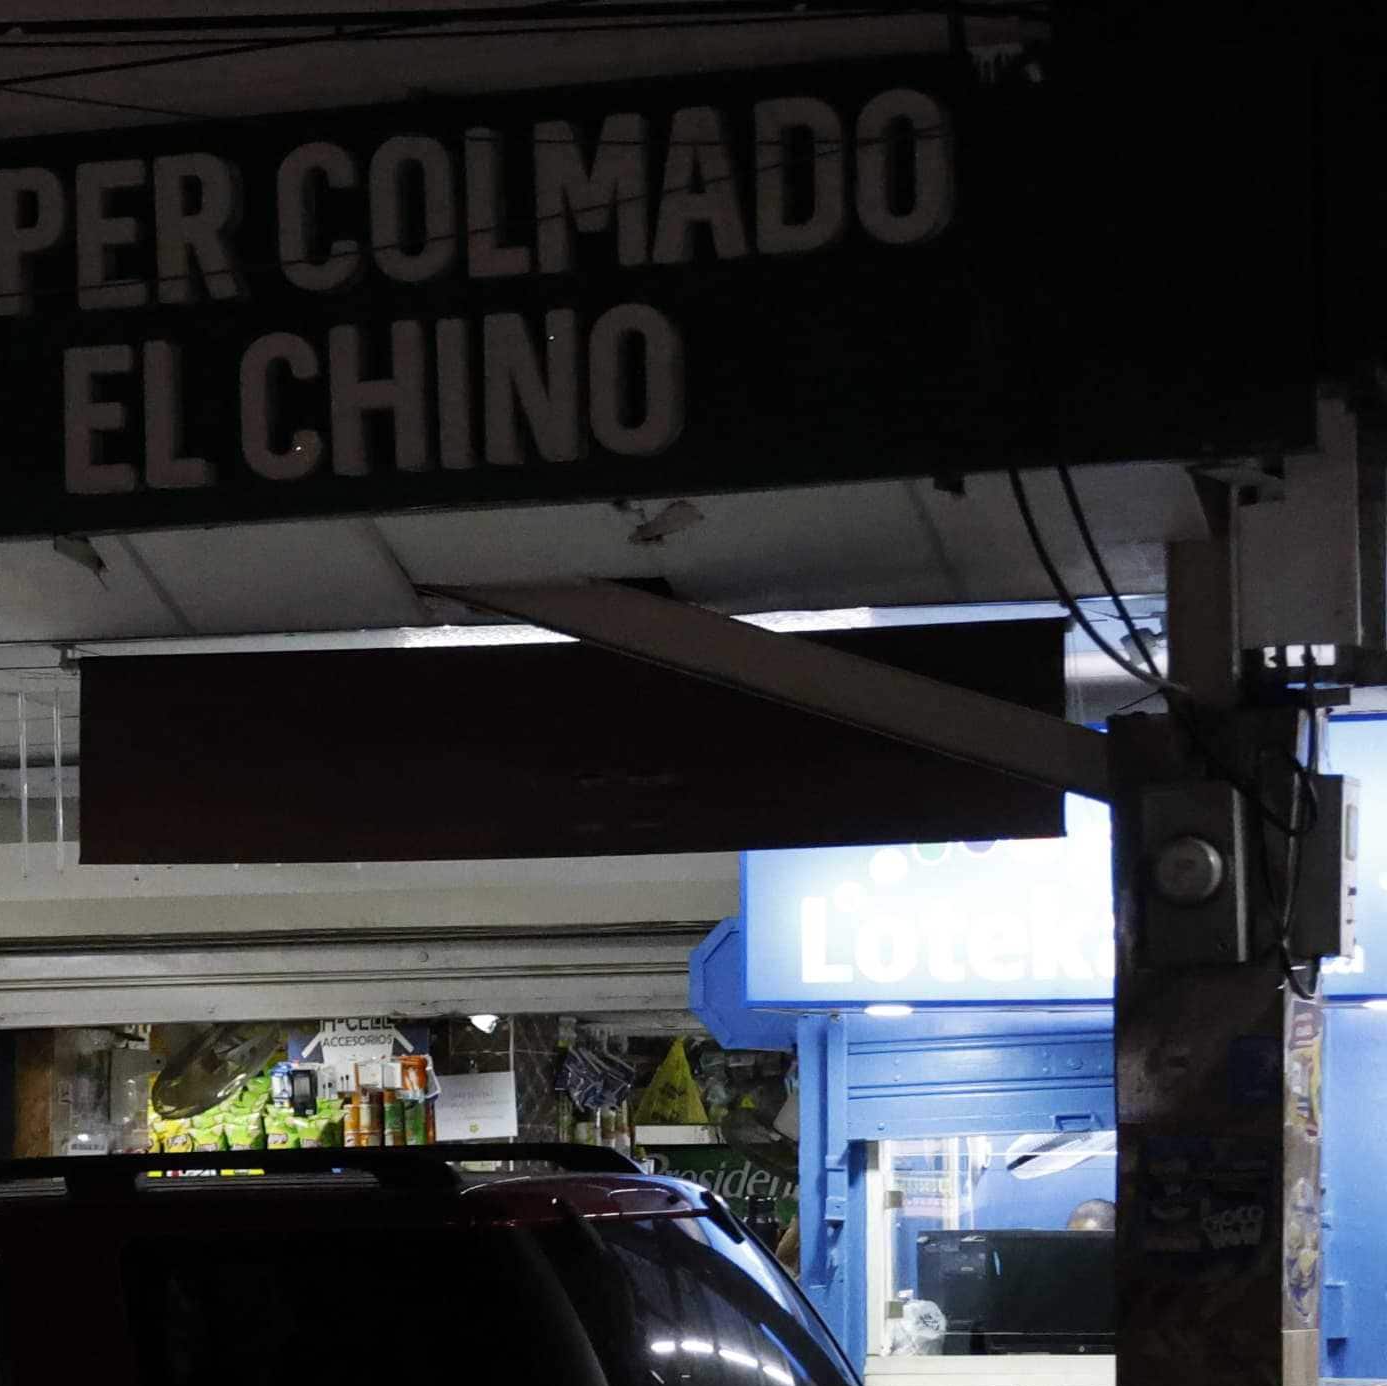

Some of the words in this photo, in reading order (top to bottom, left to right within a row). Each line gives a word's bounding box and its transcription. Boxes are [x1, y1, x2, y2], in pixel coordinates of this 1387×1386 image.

[275, 87, 959, 292] COLMADO
[61, 336, 221, 498] EL
[237, 301, 688, 483] CHINO
[800, 881, 1113, 984] Lotek
[322, 1033, 393, 1049] ACCESORIOS
